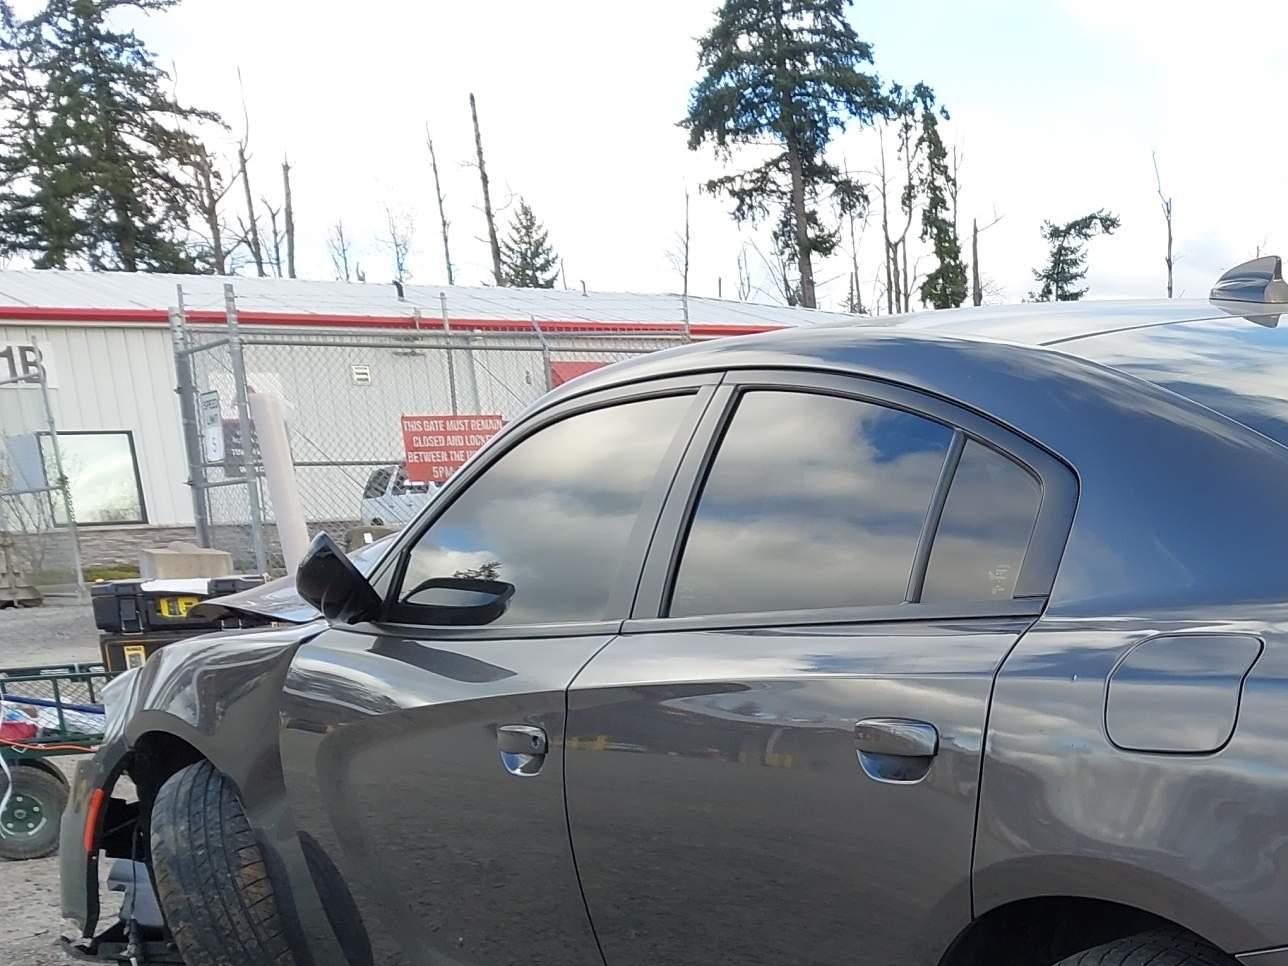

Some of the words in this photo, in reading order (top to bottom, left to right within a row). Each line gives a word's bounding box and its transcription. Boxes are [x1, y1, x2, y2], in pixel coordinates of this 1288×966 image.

[403, 420, 423, 432] THIS
[423, 420, 444, 431] GATE
[446, 419, 469, 431] MUST
[471, 419, 503, 431] REMAIN
[412, 435, 445, 447] CLOSED
[446, 435, 464, 447] AND
[407, 451, 448, 463] BETWEEN
[449, 450, 464, 462] THE
